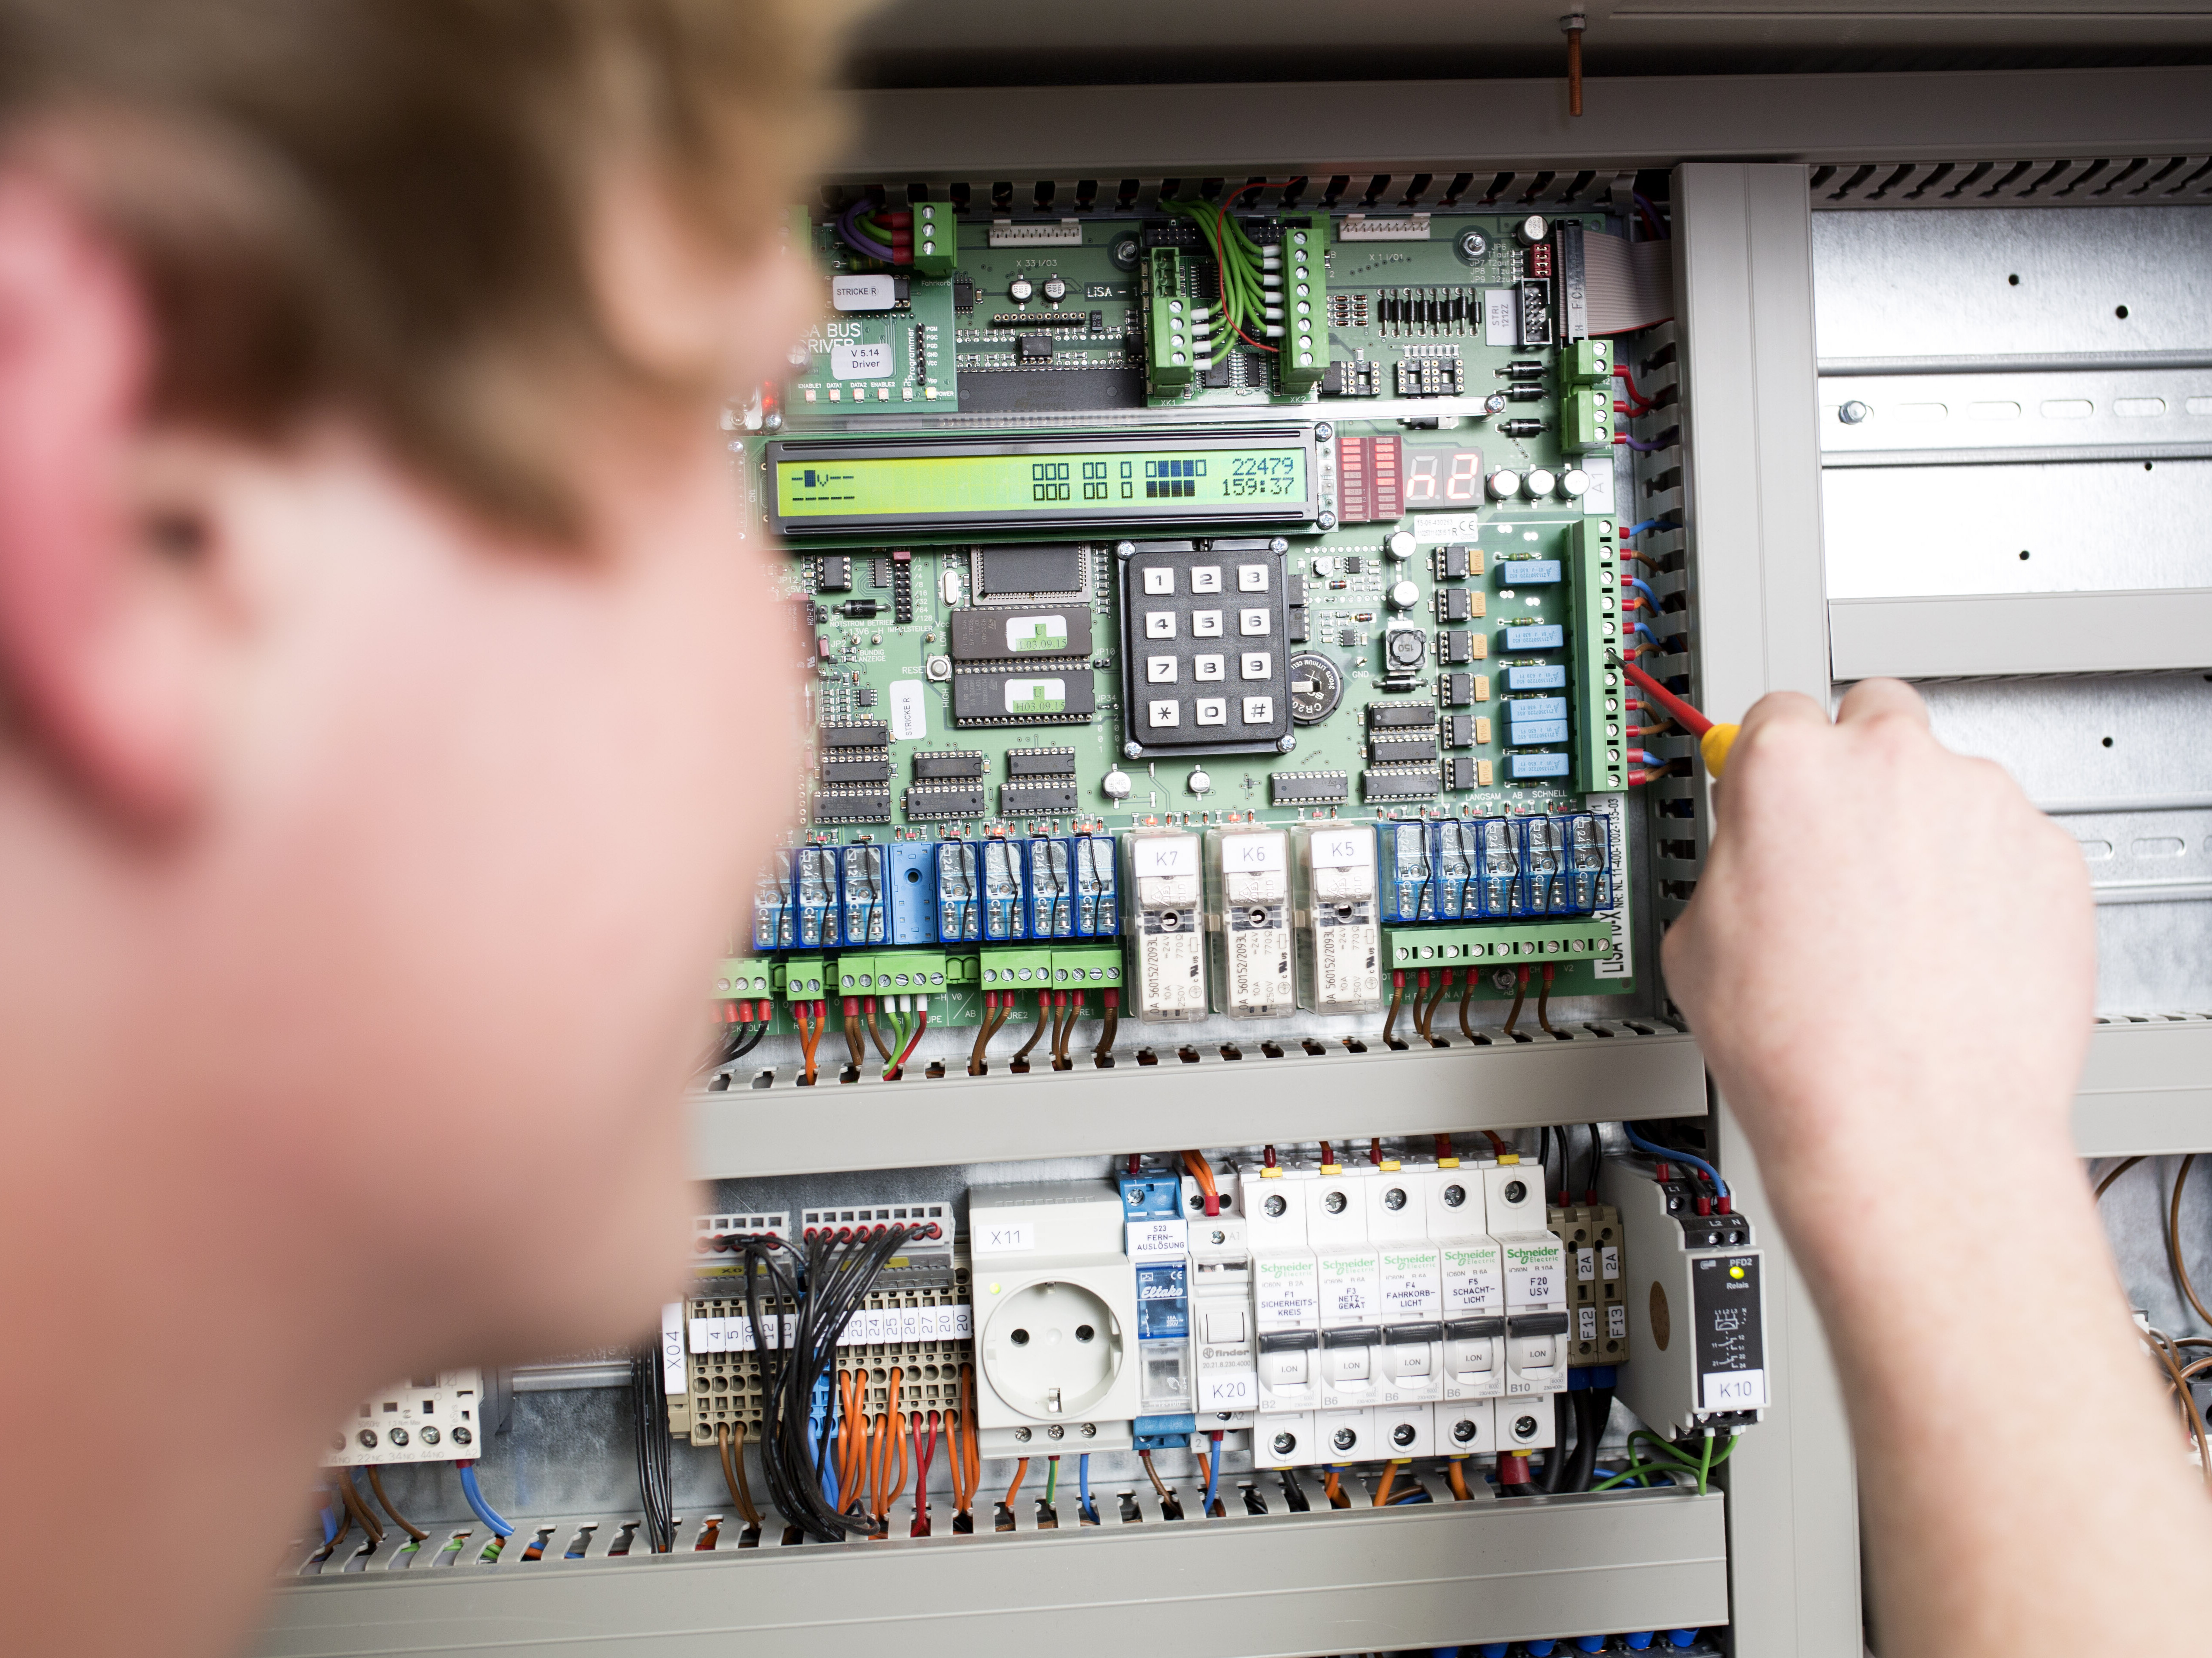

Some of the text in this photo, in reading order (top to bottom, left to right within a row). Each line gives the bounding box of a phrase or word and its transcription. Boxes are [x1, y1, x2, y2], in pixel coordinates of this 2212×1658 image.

[828, 323, 861, 337] BUS
[908, 327, 917, 381] Programmer
[1233, 458, 1294, 475] 22479
[1223, 478, 1294, 497] 159:37
[1592, 472, 1604, 493] A1
[1155, 572, 1260, 586] 1 2 3
[1155, 616, 1261, 630] 4 5 6
[1036, 626, 1043, 636] U
[1019, 639, 1067, 650] L03.09.15
[1156, 661, 1263, 674] 7 8 9
[1034, 689, 1041, 698] U
[1017, 701, 1065, 711] H03.09.15
[1205, 707, 1218, 718] 0
[1243, 847, 1266, 861] K6
[1332, 842, 1354, 857] K5
[1156, 851, 1178, 866] K7
[991, 1230, 1021, 1244] X11
[1137, 1241, 1184, 1250] AUSLÖSUNG
[1445, 1249, 1497, 1260] Schneider
[1507, 1247, 1559, 1259] Schneider
[1323, 1259, 1375, 1269] Schneider
[1384, 1254, 1437, 1265] Schneider
[1581, 1255, 1592, 1273] 2A
[1606, 1253, 1617, 1272] 2A
[1261, 1262, 1313, 1272] Schneider
[1530, 1277, 1547, 1285] F20
[1141, 1285, 1184, 1299] Eltako
[1386, 1290, 1435, 1299] FAHRKORB-
[1453, 1286, 1495, 1296] SCHACHT-
[1530, 1288, 1549, 1296] USV
[1261, 1299, 1317, 1308] SICHERHEITS-
[1464, 1296, 1485, 1304] LICHT
[711, 1314, 968, 1339] 4 5 23 24 25 26 27 20 20
[1582, 1311, 1594, 1339] F12
[1611, 1309, 1623, 1337] F13
[667, 1330, 681, 1369] X04
[1213, 1382, 1245, 1398] K20
[1447, 1389, 1461, 1398] B6
[1510, 1383, 1530, 1393] B10
[1720, 1381, 1751, 1398] K10
[1324, 1397, 1338, 1405] B6
[1385, 1392, 1399, 1402] B6
[1262, 1400, 1276, 1409] B2
